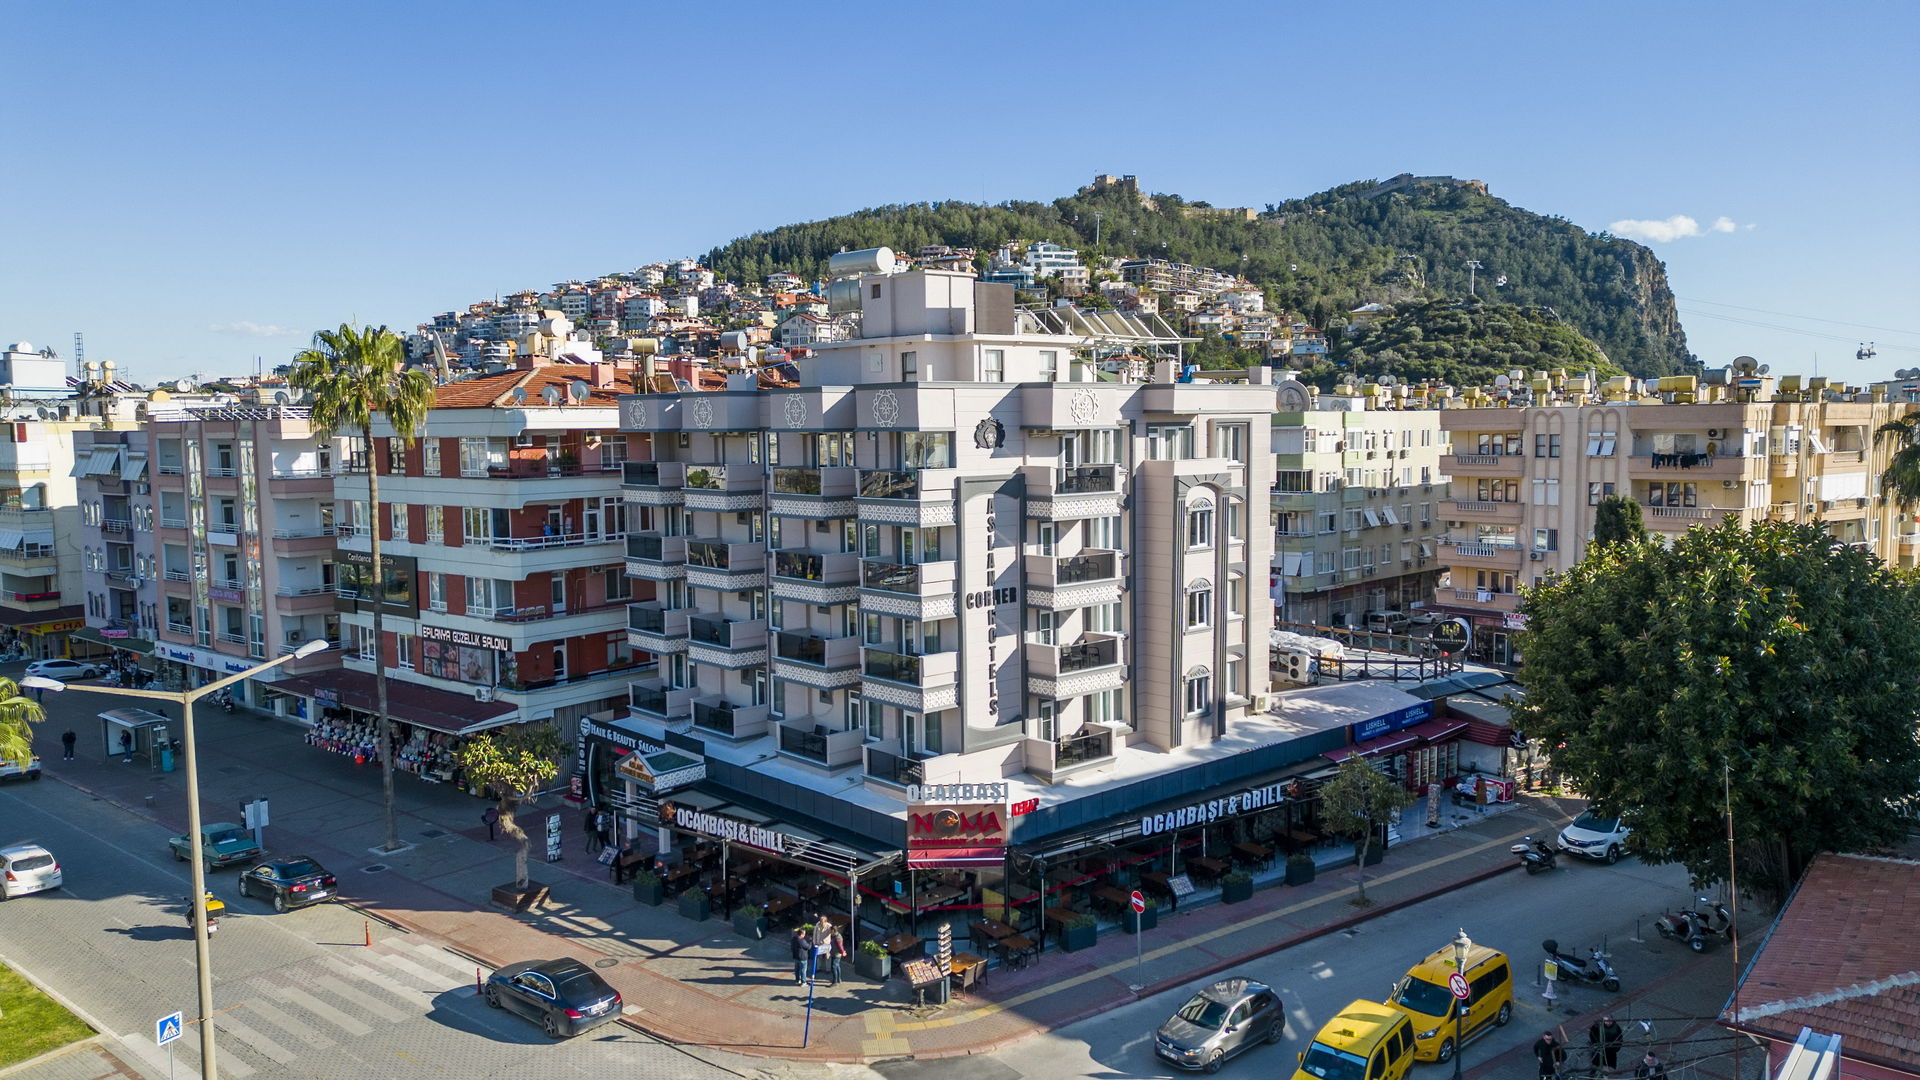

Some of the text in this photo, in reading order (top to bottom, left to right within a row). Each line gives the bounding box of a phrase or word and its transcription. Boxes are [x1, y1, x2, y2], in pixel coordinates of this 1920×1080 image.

[986, 498, 996, 588] ASLAN
[966, 587, 1017, 610] CORNER
[986, 609, 998, 716] HOTELS
[907, 782, 1009, 803] OCAKBAŞI
[1142, 784, 1284, 836] OCAKBAŞI & GRILL
